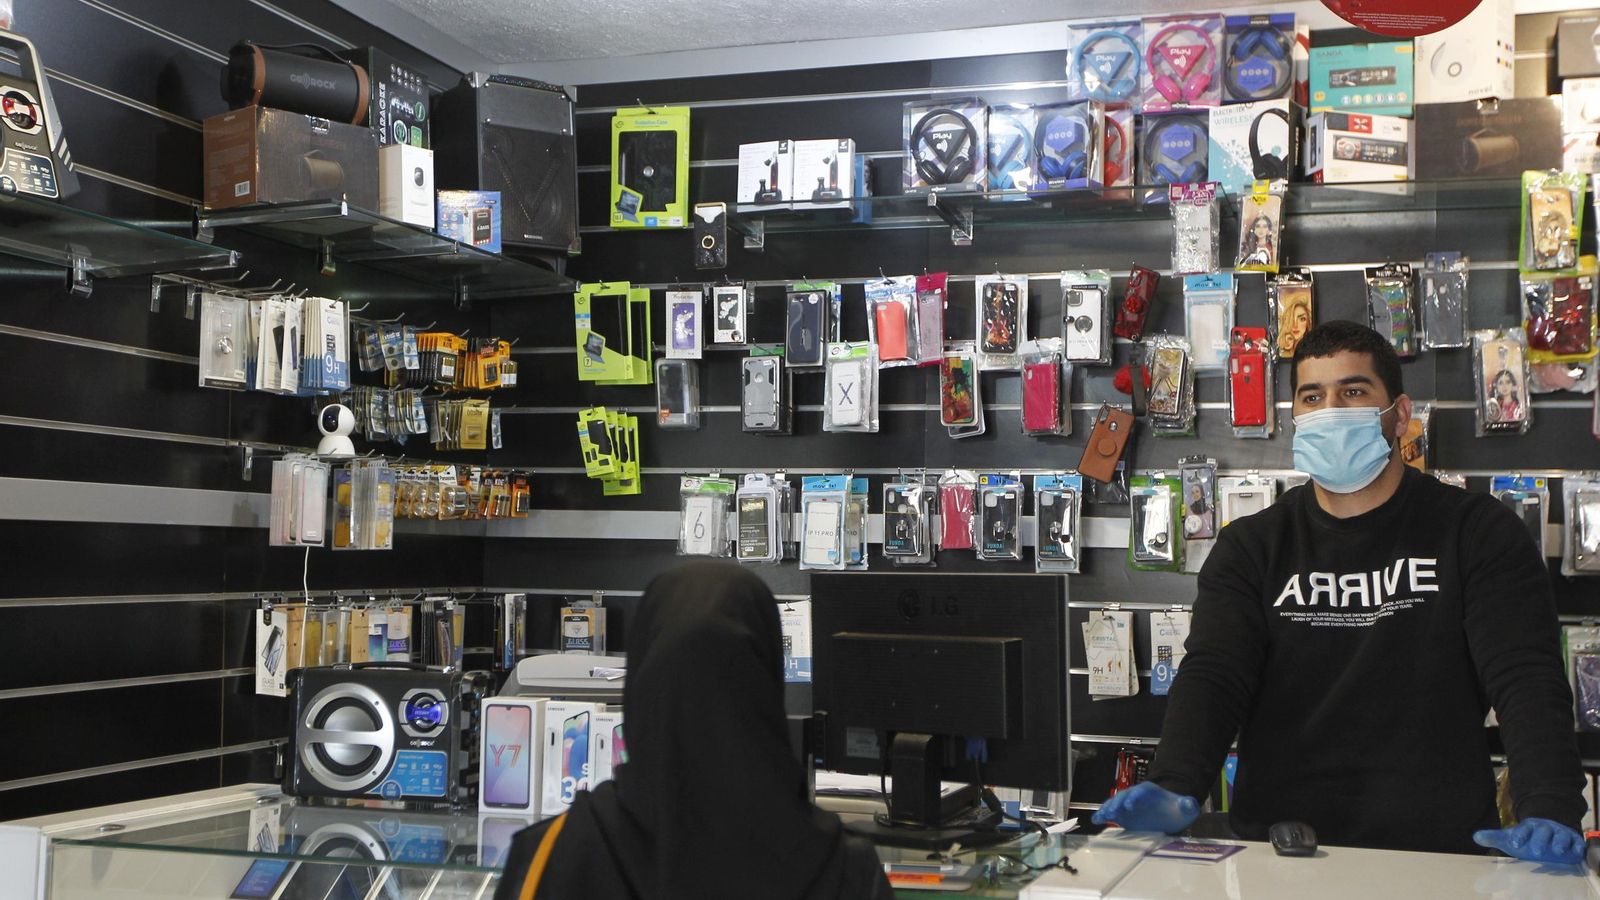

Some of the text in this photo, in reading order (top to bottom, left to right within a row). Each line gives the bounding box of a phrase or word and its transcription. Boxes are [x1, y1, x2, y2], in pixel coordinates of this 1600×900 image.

[933, 132, 952, 140] Play
[838, 382, 853, 405] X
[694, 511, 705, 539] 6
[1273, 558, 1439, 607] ARRIVE
[931, 596, 958, 615] LG
[1092, 666, 1104, 674] 9H
[490, 743, 522, 769] Y7
